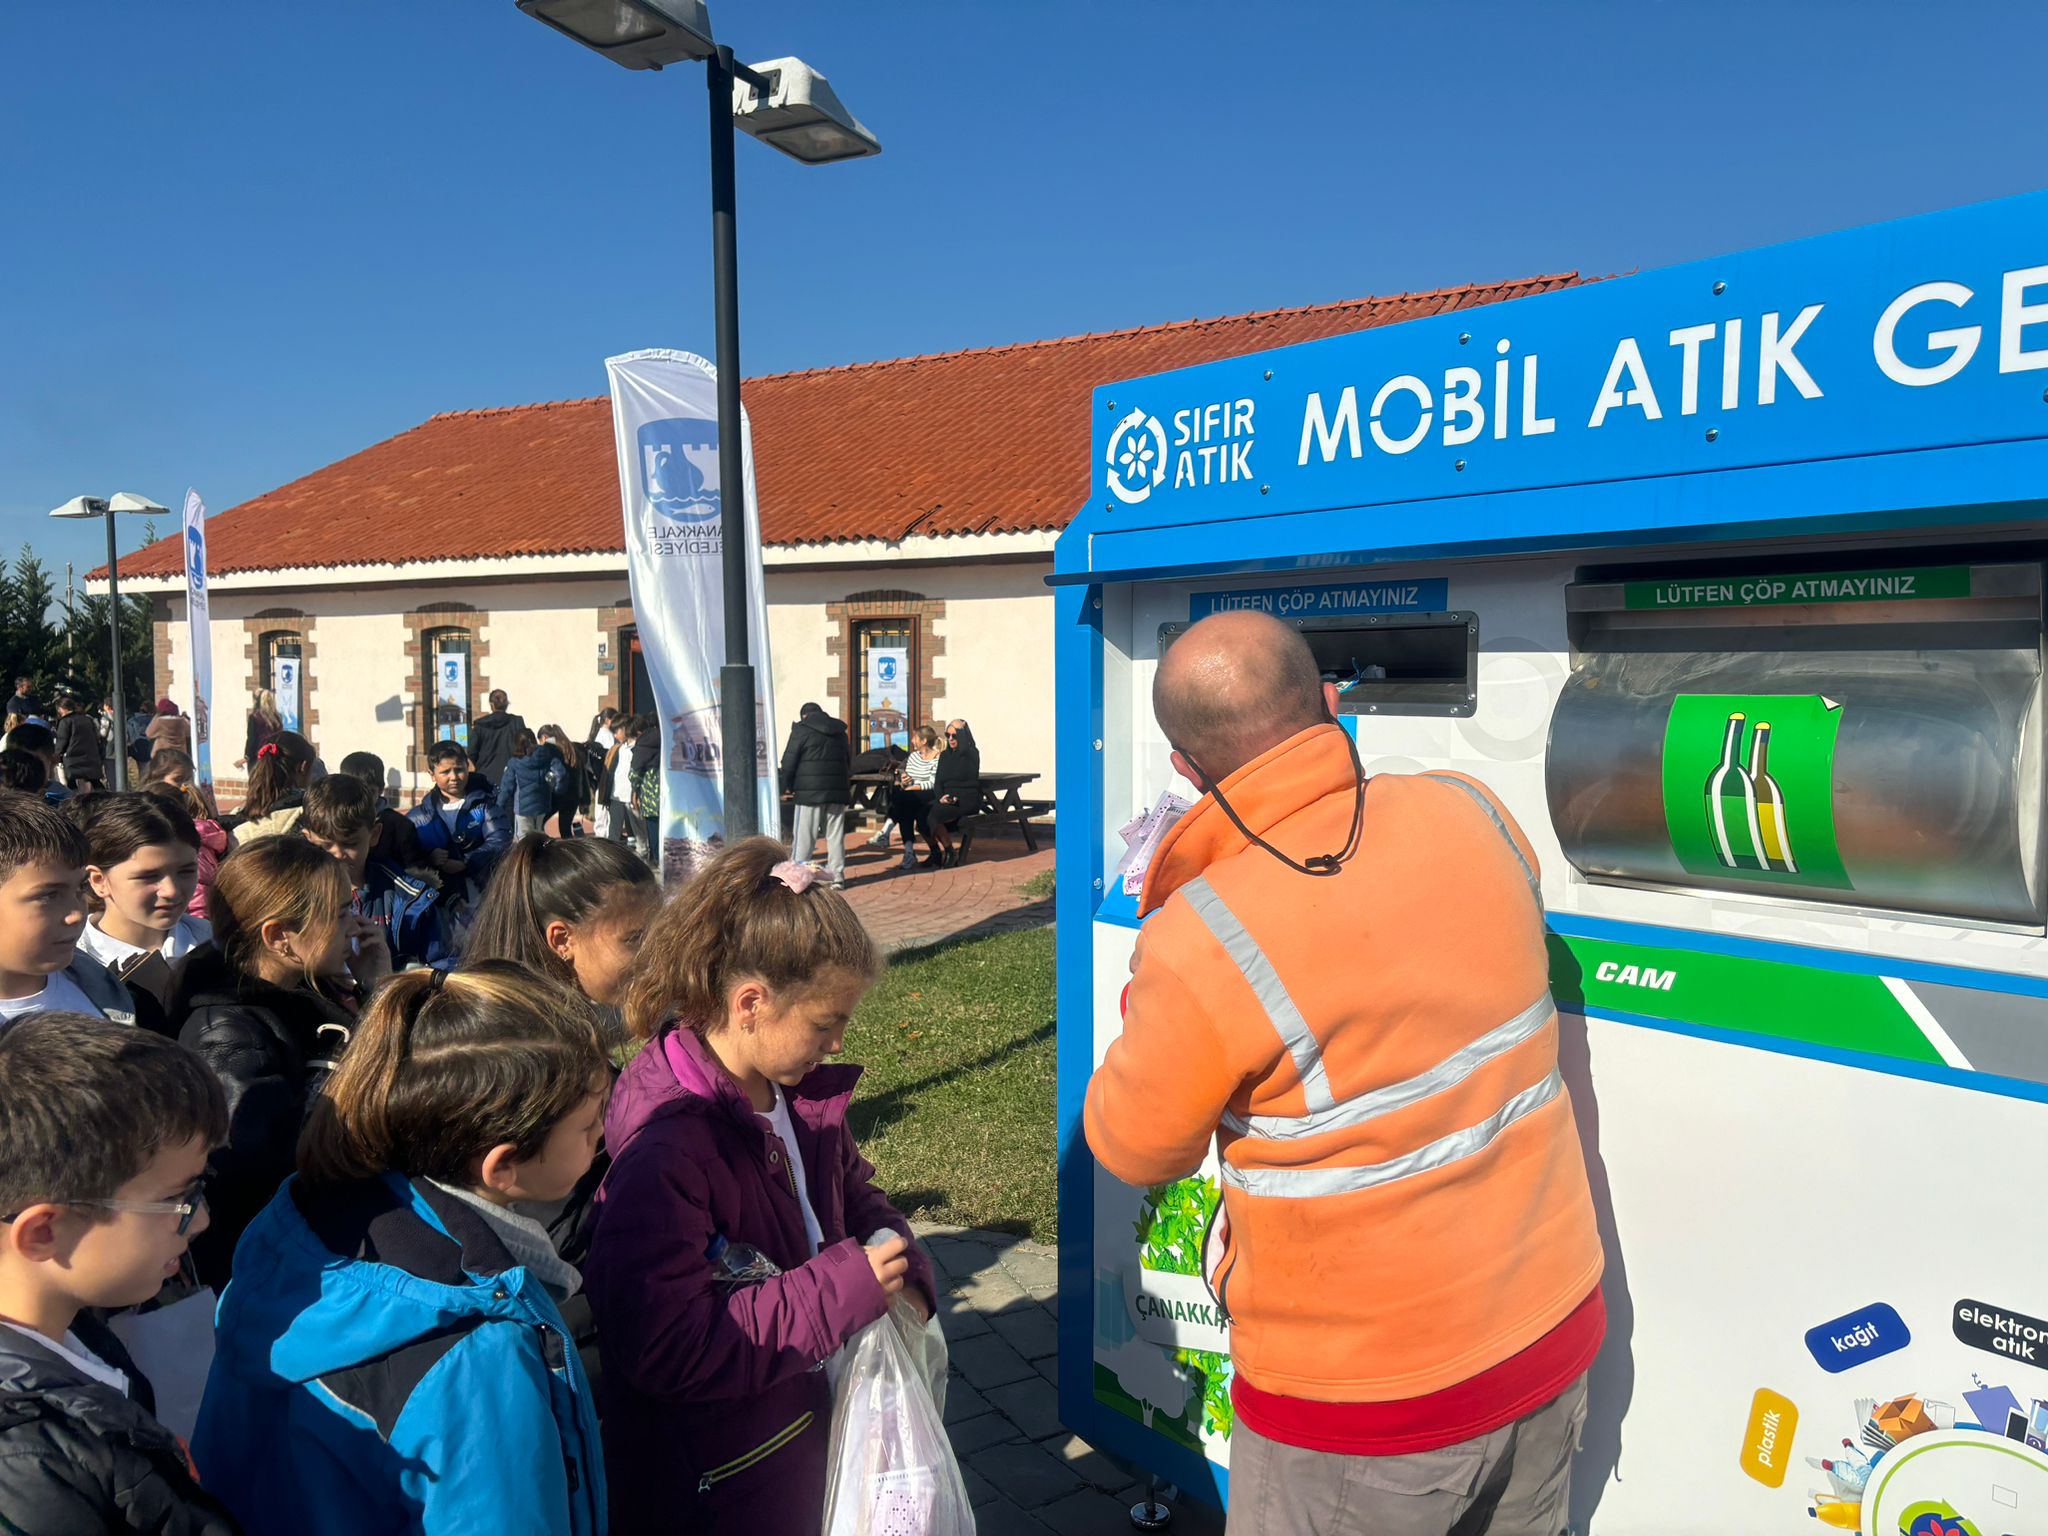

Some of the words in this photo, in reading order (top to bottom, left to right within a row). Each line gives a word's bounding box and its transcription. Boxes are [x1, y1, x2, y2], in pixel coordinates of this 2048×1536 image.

[1297, 338, 1556, 466] MOBİL
[1587, 303, 1826, 428] ATIK
[1873, 264, 2048, 387] GE
[1174, 398, 1255, 446] SIFIR
[1173, 440, 1255, 489] ATIK
[1278, 588, 1315, 615] ÇÖP
[1319, 586, 1419, 609] ATMAYINIZ
[1656, 583, 1734, 604] LÜTFEN
[1740, 579, 1786, 604] ÇÖP
[1791, 576, 1916, 598] ATMAYINIZ
[1595, 961, 1677, 991] CAM
[1830, 1321, 1880, 1352] kağıt
[1992, 1336, 2035, 1360] atık
[1756, 1409, 1781, 1468] plastik
